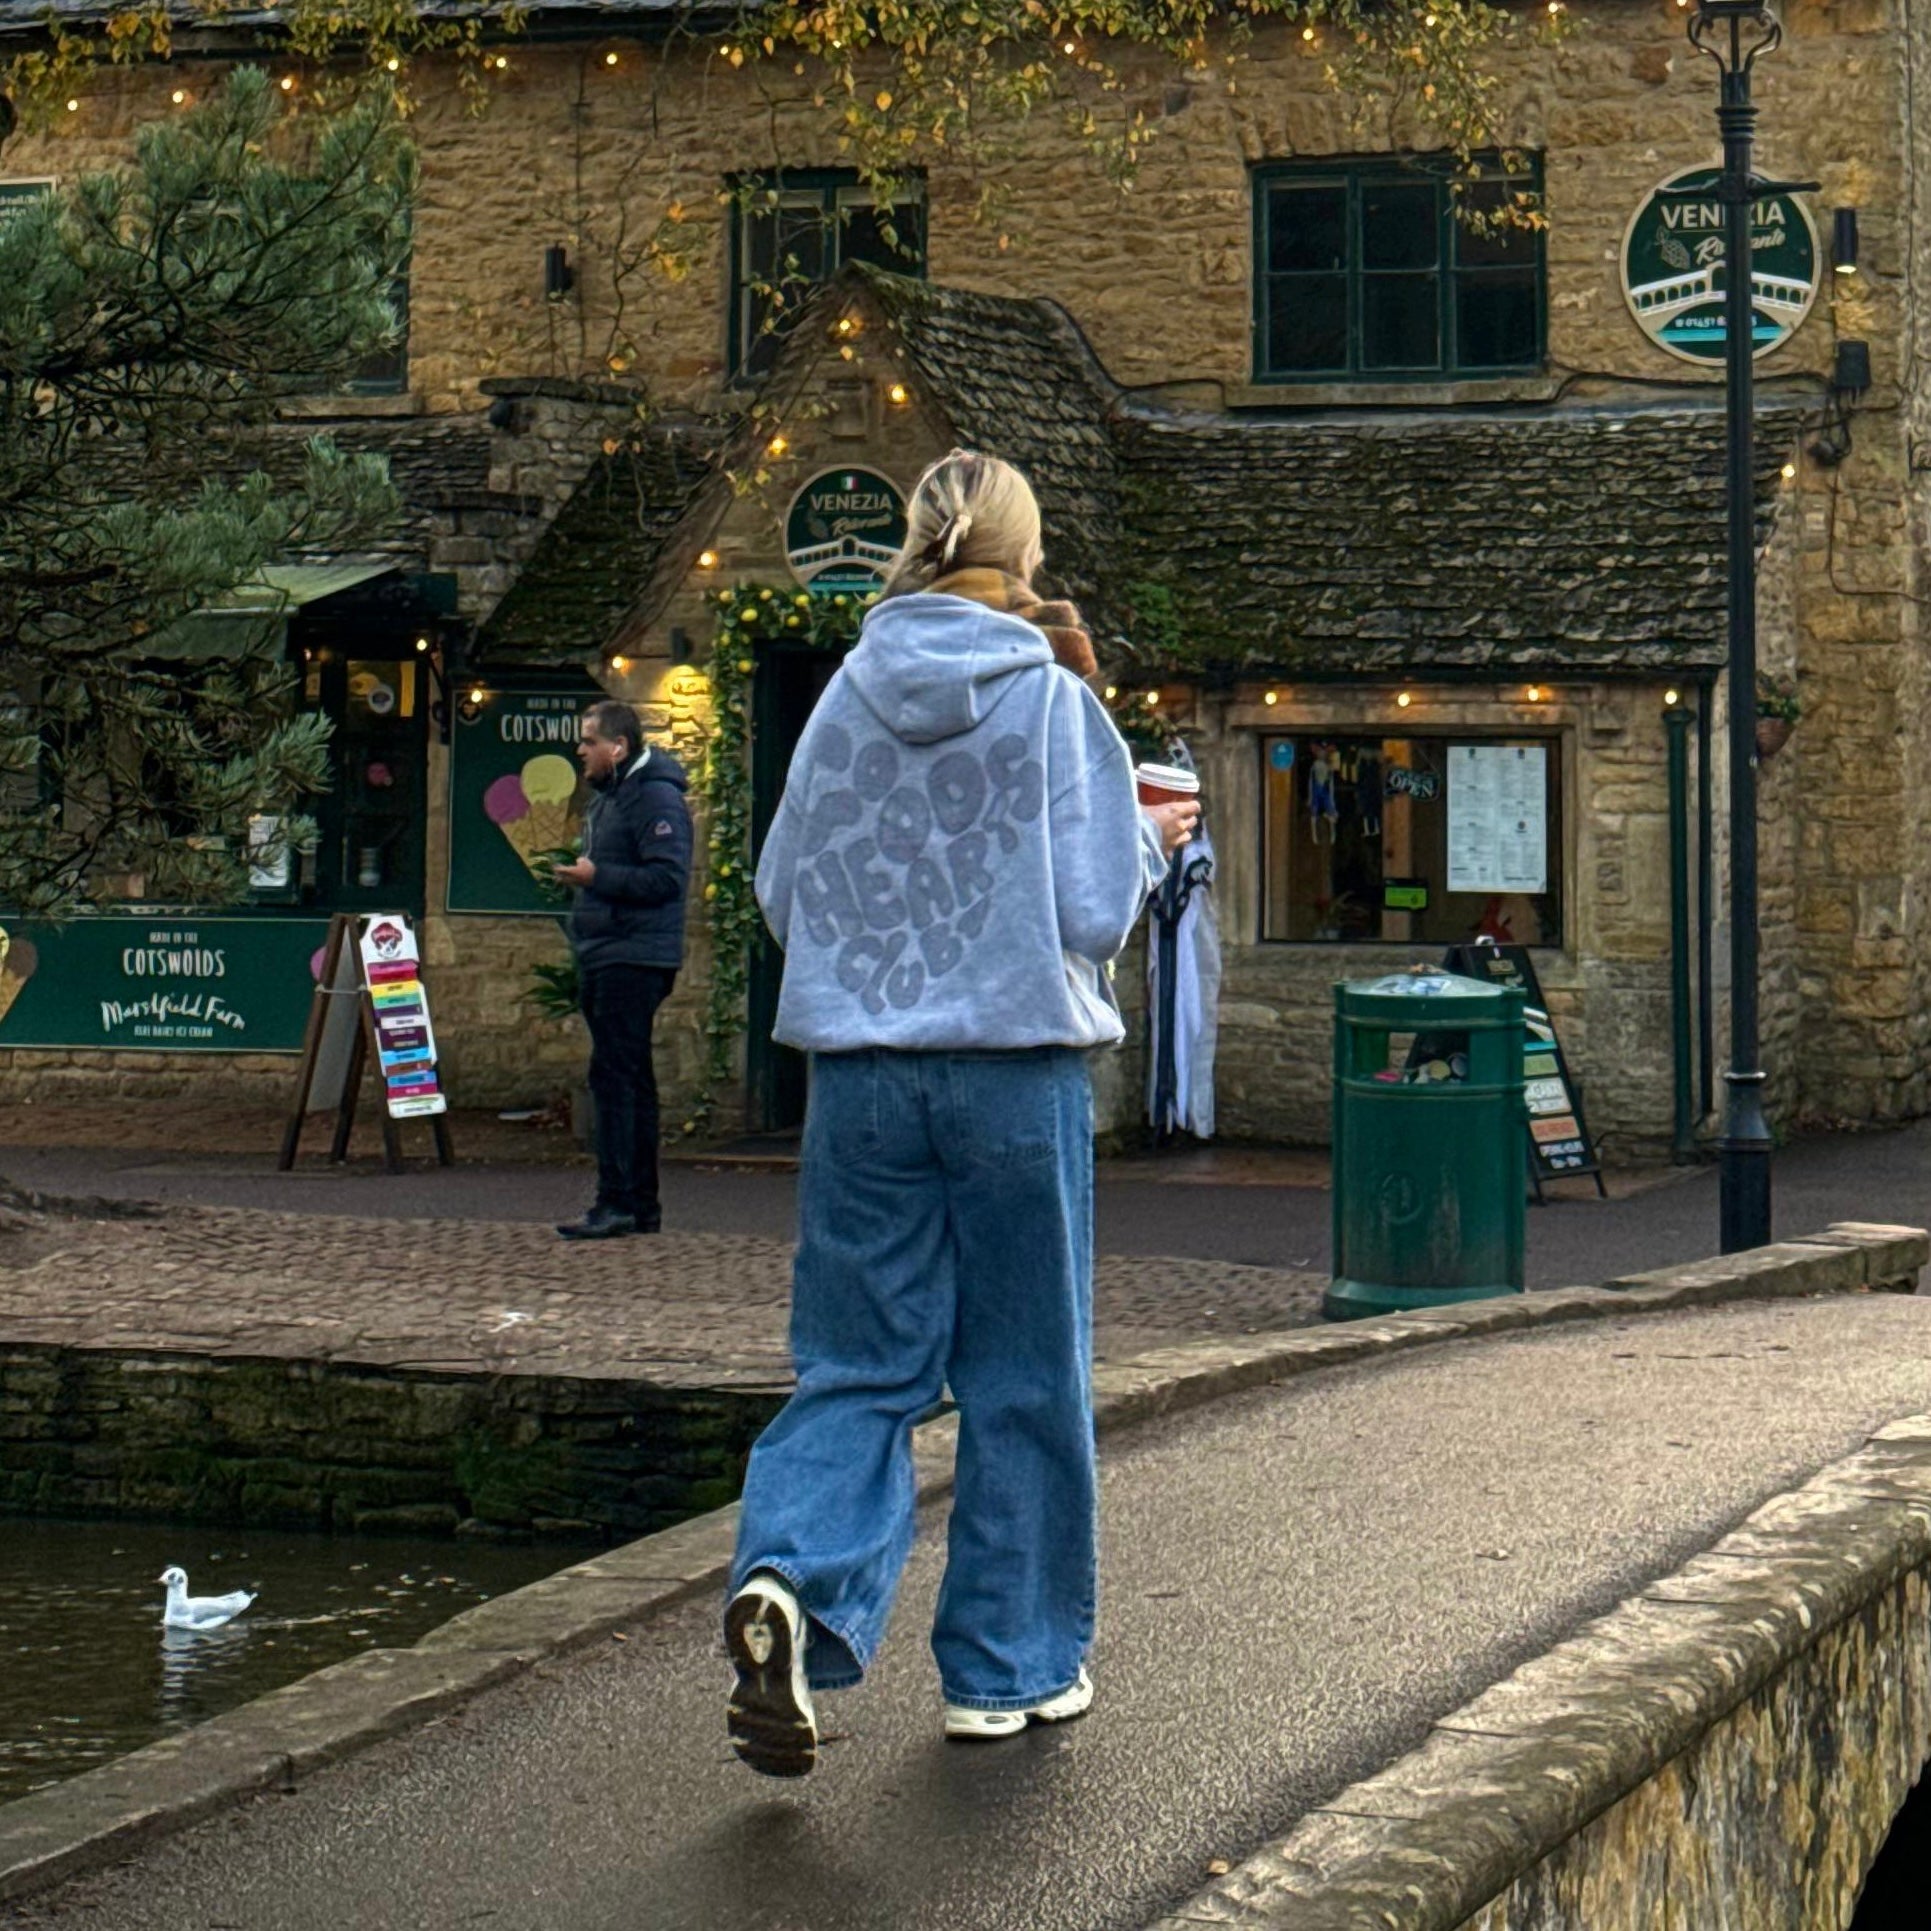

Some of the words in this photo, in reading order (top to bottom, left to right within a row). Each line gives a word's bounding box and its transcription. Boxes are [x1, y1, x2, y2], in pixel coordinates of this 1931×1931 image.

[1660, 200, 1786, 229] VENIA
[810, 493, 893, 511] VENEZIA
[501, 714, 581, 742] COTSWOL
[123, 948, 226, 977] COTSWOLDS
[100, 991, 203, 1033] Marshfield
[203, 995, 246, 1031] Farm
